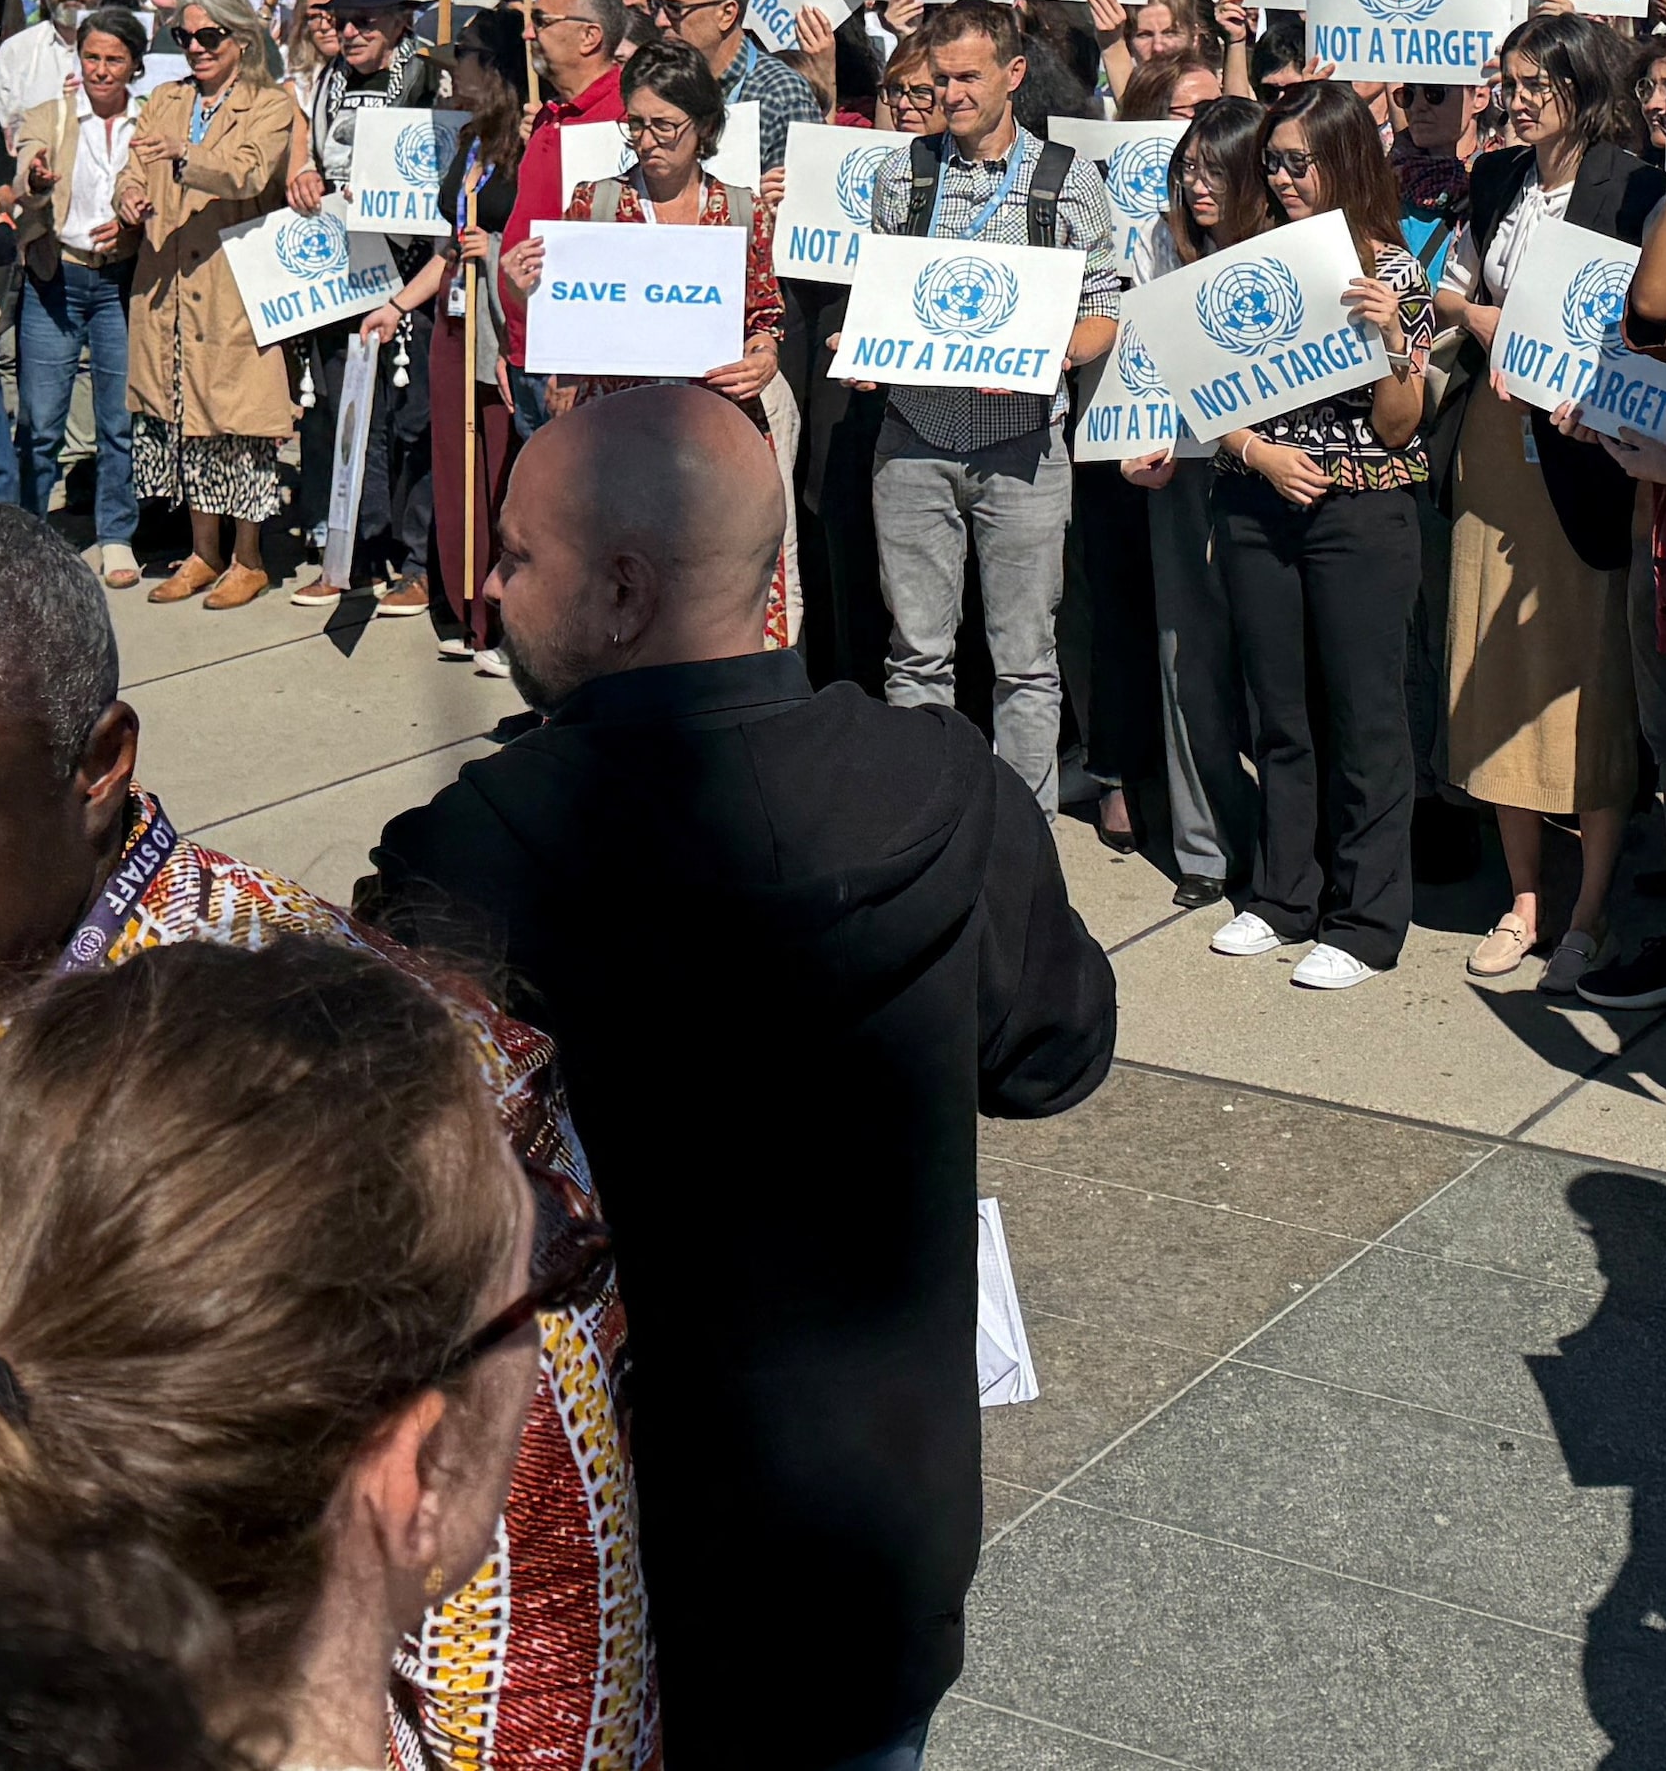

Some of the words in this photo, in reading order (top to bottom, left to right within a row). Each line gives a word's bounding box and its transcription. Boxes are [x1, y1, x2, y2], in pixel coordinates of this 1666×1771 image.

[1315, 24, 1365, 62] NOT
[1368, 28, 1386, 63] A
[1391, 28, 1493, 67] TARGET
[361, 191, 401, 220] NOT
[405, 190, 418, 220] A
[789, 226, 842, 265] NOT
[844, 232, 860, 267] A
[259, 292, 308, 329] NOT
[310, 284, 327, 314] A
[322, 263, 392, 306] TARGET
[551, 280, 627, 303] SAVE
[644, 283, 722, 305] GAZA
[851, 336, 913, 369] NOT
[912, 341, 933, 370] A
[941, 343, 1051, 378] TARGET
[1190, 370, 1252, 421] NOT
[1251, 363, 1279, 400] A
[1268, 322, 1373, 390] TARGET
[1502, 330, 1554, 383] NOT
[1546, 352, 1570, 393] A
[1086, 405, 1123, 442] NOT
[1127, 403, 1141, 441] A
[105, 843, 161, 916] STAFF
